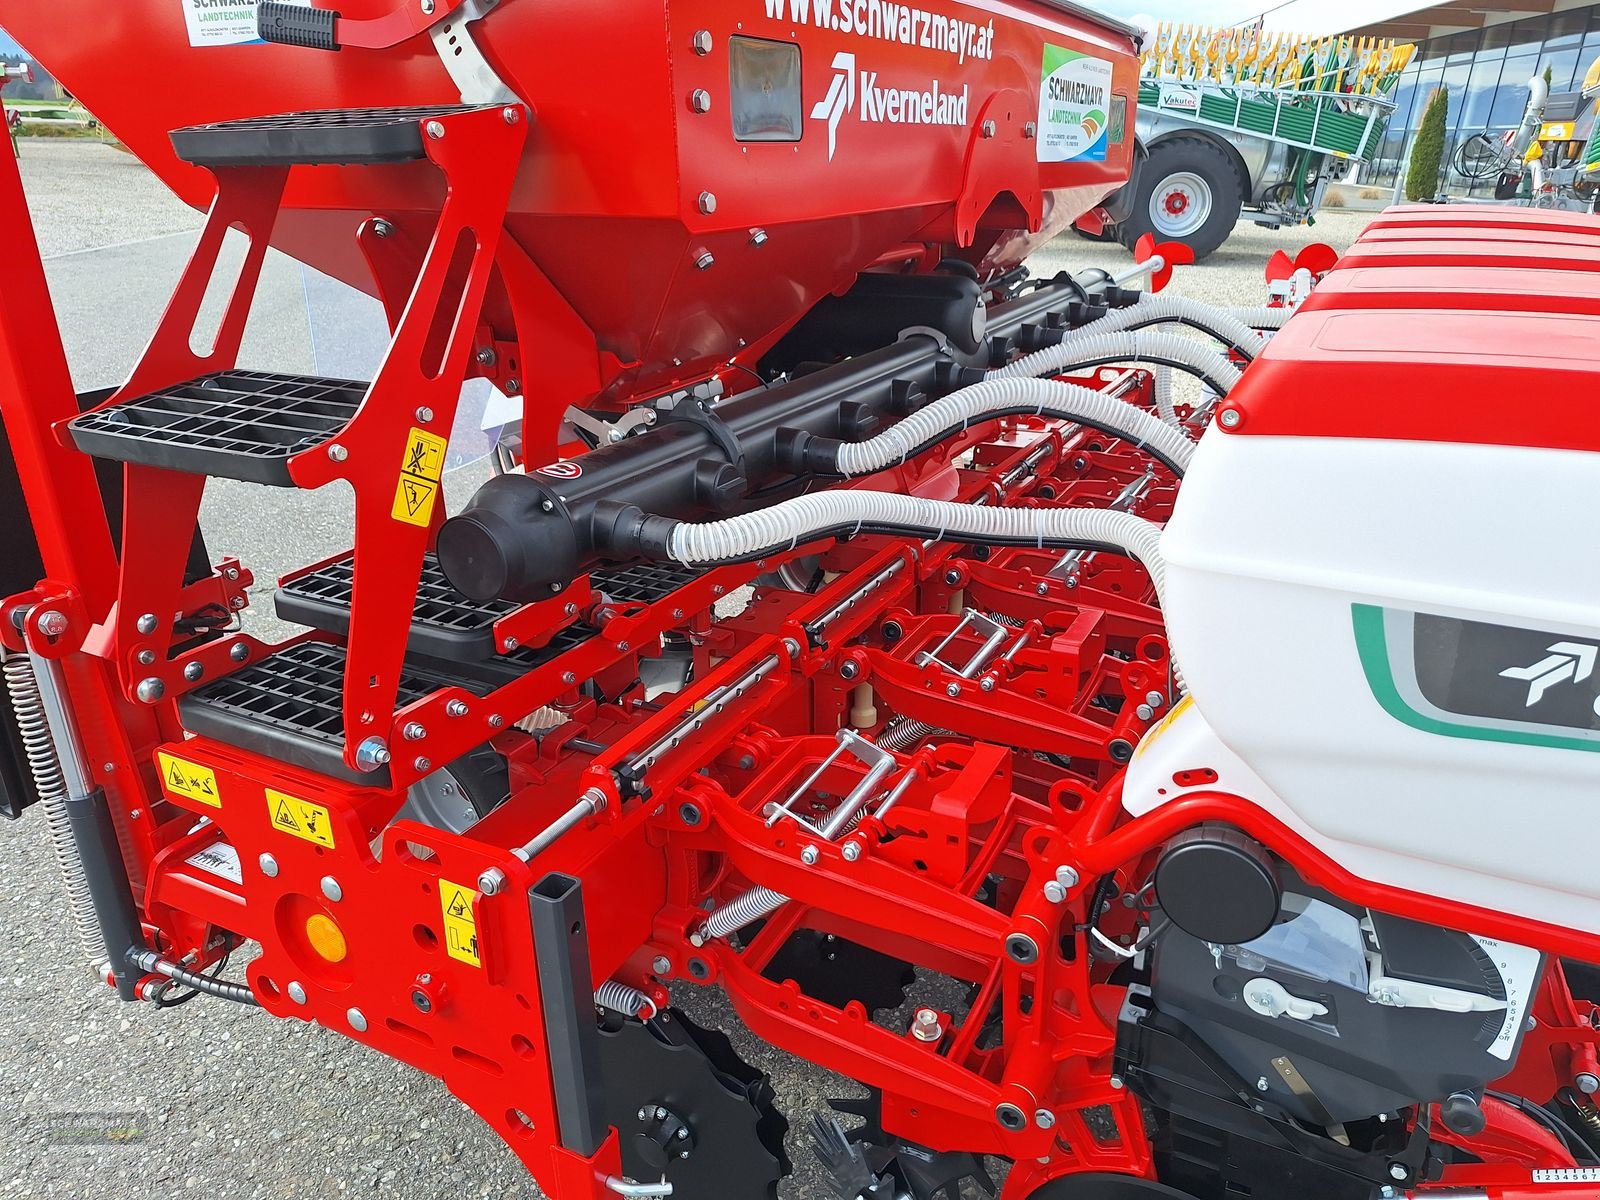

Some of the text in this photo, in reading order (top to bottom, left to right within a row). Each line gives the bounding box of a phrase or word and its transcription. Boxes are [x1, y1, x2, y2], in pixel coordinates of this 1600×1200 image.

[198, 10, 254, 22] LANDTECHNIK
[764, 0, 994, 64] www.schwarzmayr.at
[860, 71, 968, 125] Kverneland
[1048, 76, 1104, 106] SCHWARZMAYR
[1479, 938, 1498, 948] max
